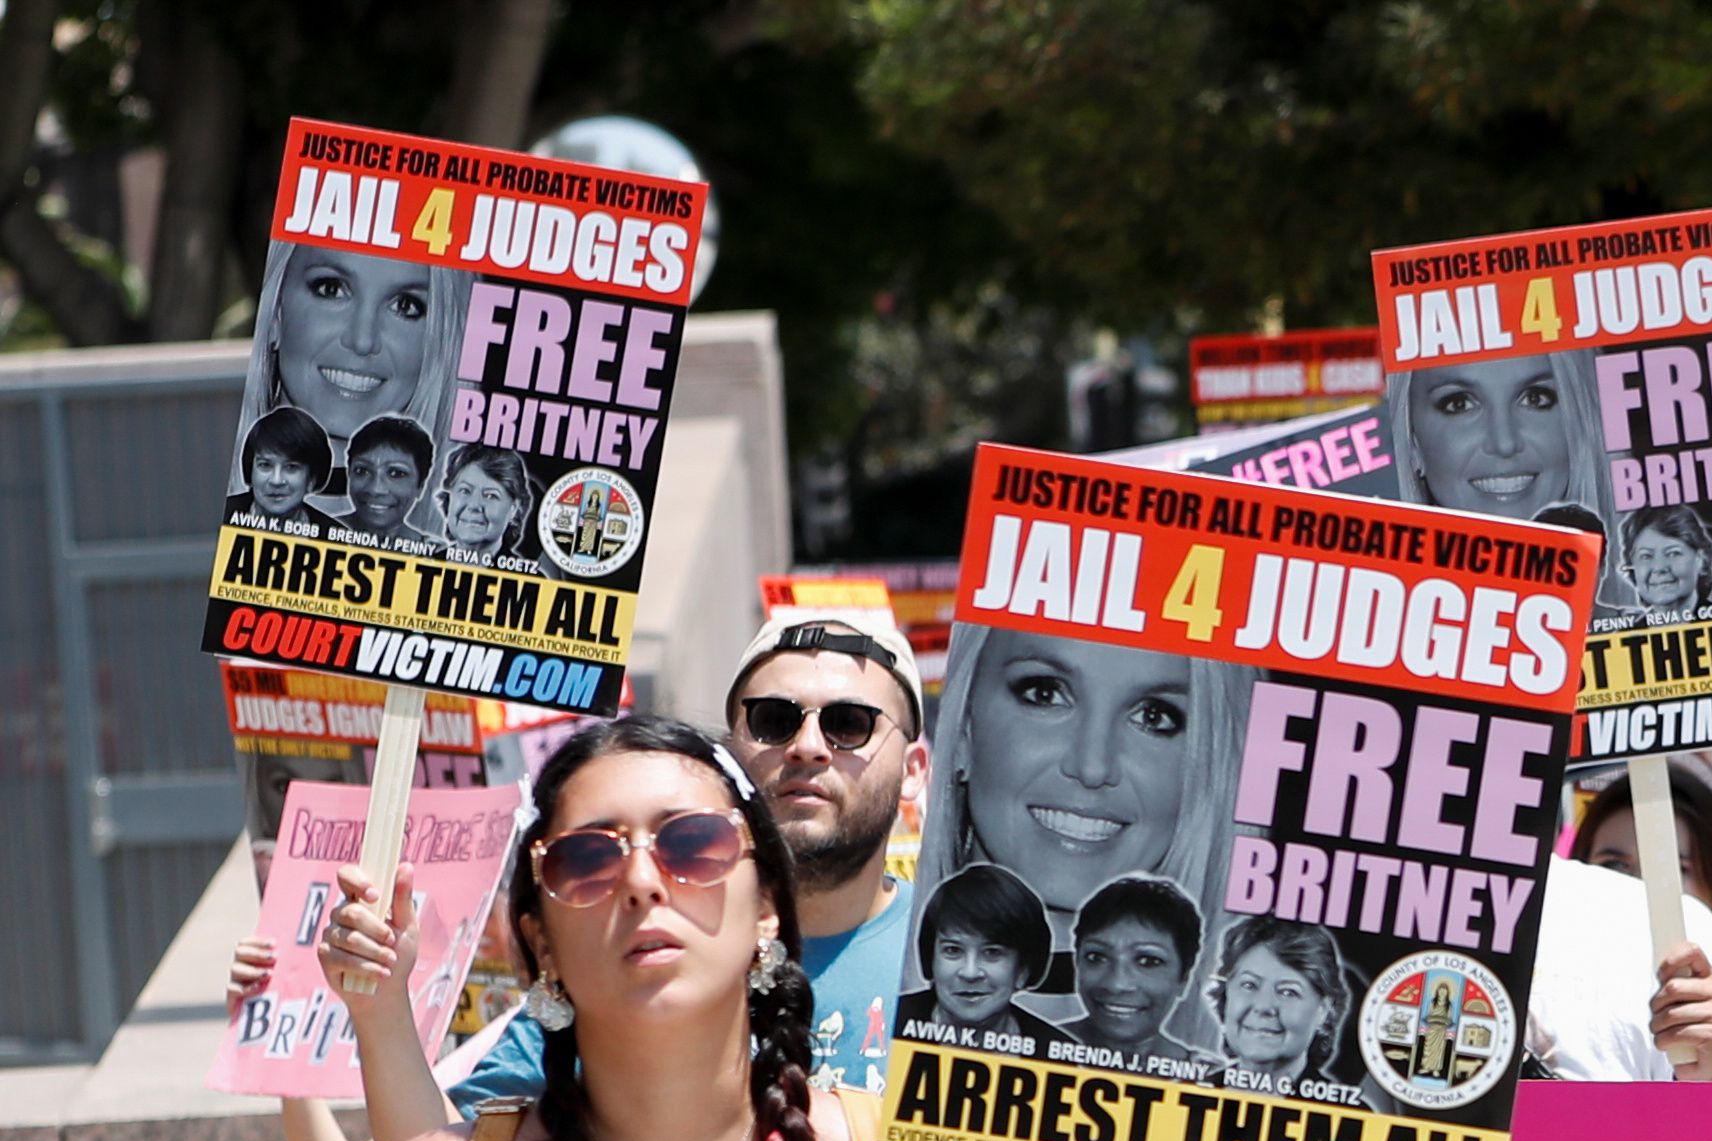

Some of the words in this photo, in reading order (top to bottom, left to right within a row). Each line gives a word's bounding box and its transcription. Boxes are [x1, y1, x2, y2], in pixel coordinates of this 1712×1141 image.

[301, 133, 391, 170] JUSTICE
[396, 148, 439, 177] FOR
[444, 156, 479, 183] ALL
[486, 162, 589, 201] PROBATE
[596, 179, 692, 217] VICTIMS
[284, 166, 400, 248] JAIL
[411, 188, 454, 255] 4
[460, 194, 687, 292] JUDGES
[1391, 252, 1481, 285] JUSTICE
[1486, 246, 1529, 273] FOR
[1536, 241, 1572, 267] ALL
[1578, 227, 1682, 261] PROBATE
[457, 282, 672, 409] FREE
[1395, 283, 1512, 361] JAIL
[1521, 277, 1562, 341] 4
[449, 387, 657, 469] BRITNEY
[228, 512, 267, 531] AVIVA
[267, 518, 282, 533] K.
[283, 521, 320, 539] BOBB
[326, 528, 381, 549] BRENDA
[380, 536, 393, 551] J.
[393, 538, 437, 558] PENNY
[445, 546, 481, 565] REVA
[481, 552, 496, 567] G.
[496, 555, 540, 574] GOETZ
[995, 465, 1129, 518] JUSTICE
[1138, 486, 1201, 527] FOR
[1208, 497, 1260, 538] ALL
[1272, 506, 1425, 562] PROBATE
[1435, 531, 1577, 585] VICTIMS
[216, 585, 274, 607] EVIDENCE,
[274, 594, 342, 617] FINANCIALS,
[342, 605, 392, 623] WITNESS
[393, 613, 465, 635] STATEMENTS
[467, 625, 475, 636] &
[477, 626, 571, 651] DOCUMENTATION
[572, 641, 610, 658] PROVE
[610, 648, 622, 660] IT
[223, 534, 405, 608] ARREST
[415, 563, 539, 631] THEM
[544, 587, 619, 645] ALL
[972, 514, 1145, 631] JAIL
[1162, 544, 1224, 641] 4
[1234, 553, 1572, 694] JUDGES
[1592, 614, 1636, 633] PENNY
[1645, 609, 1680, 627] REVA
[223, 607, 602, 708] COURTVICTIM.COM
[1614, 682, 1687, 703] STATEMENTS
[1688, 681, 1697, 693] &
[234, 693, 325, 735] JUDGES
[325, 702, 384, 739] IGNO
[1234, 681, 1552, 866] FREE
[1223, 834, 1534, 952] BRITNEY
[902, 1017, 959, 1044] AVIVA
[959, 1026, 981, 1048] K.
[982, 1030, 1037, 1056] BOBB
[1046, 1040, 1126, 1070] BRENDA
[1126, 1052, 1144, 1073] J.
[1145, 1055, 1209, 1083] PENNY
[1222, 1066, 1274, 1093] REVA
[1275, 1074, 1297, 1096] G.
[1298, 1078, 1362, 1106] GOETZ
